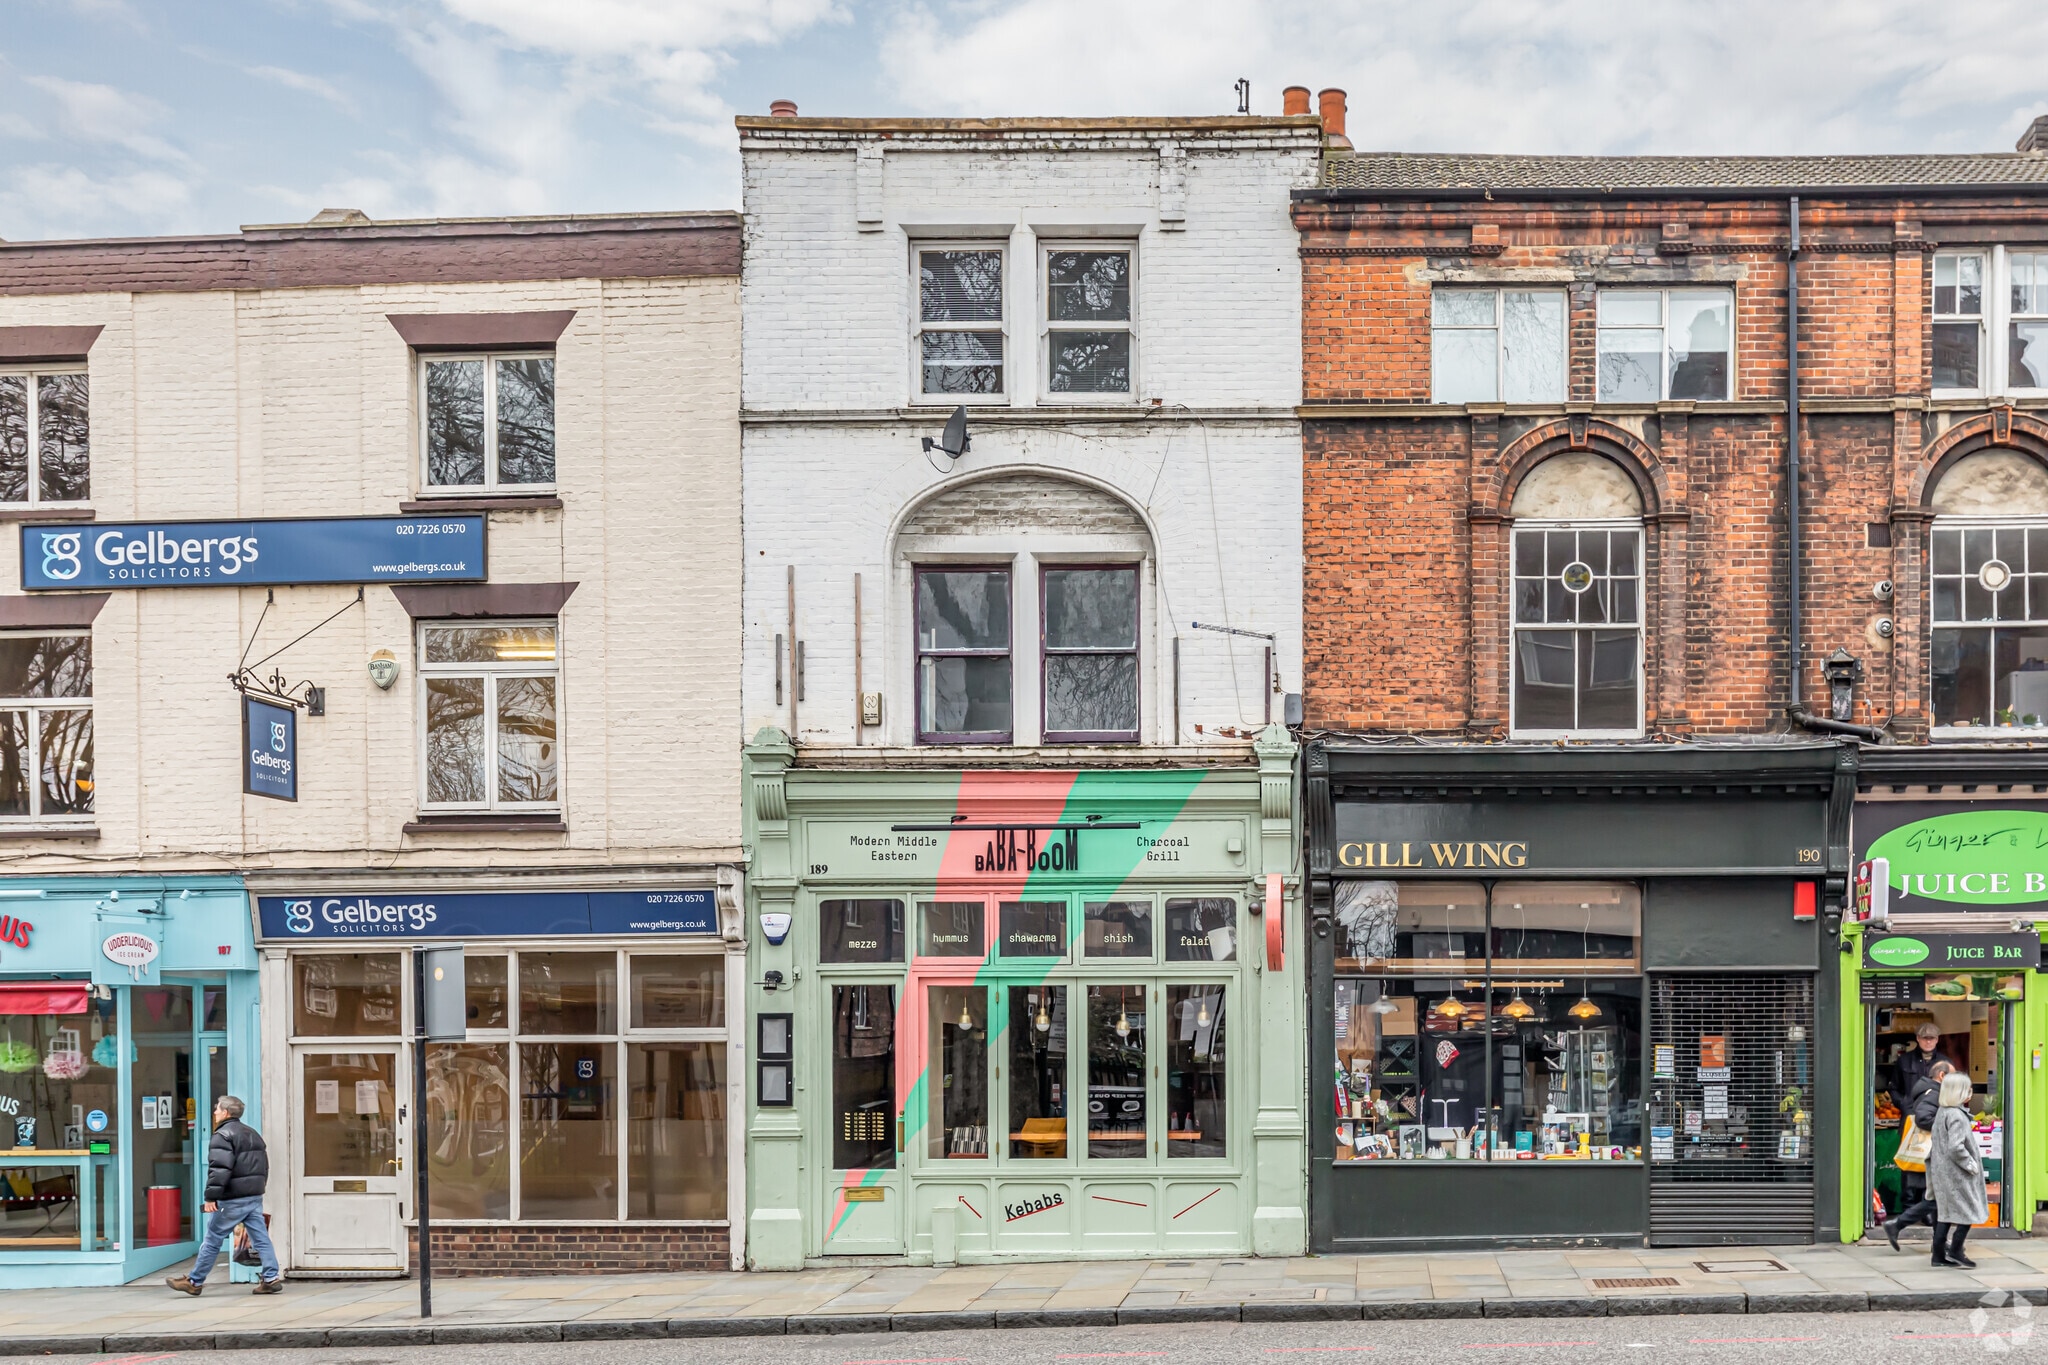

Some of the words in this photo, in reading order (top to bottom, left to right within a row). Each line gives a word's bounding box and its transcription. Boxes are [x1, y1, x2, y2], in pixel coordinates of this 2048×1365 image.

[396, 525, 414, 535] 020
[417, 524, 440, 534] 7226
[442, 523, 466, 534] 0570
[94, 530, 259, 575] Gelbergs
[109, 567, 211, 579] SOLICITORS
[372, 561, 466, 575] www.gelbergs.co.uk
[251, 749, 291, 775] Gelbergs
[256, 772, 288, 785] SOLICITORS
[850, 836, 891, 846] Modern
[897, 836, 938, 847] Middle
[1136, 836, 1190, 847] Charcoal
[975, 826, 1079, 871] BABA-BOOM
[871, 851, 918, 861] Eastern
[1146, 851, 1180, 861] Grill
[1338, 842, 1423, 867] GILL
[1429, 842, 1527, 867] WING
[1798, 849, 1820, 862] 190
[810, 864, 829, 875] 189
[1899, 872, 2011, 899] JUICE
[647, 895, 662, 903] 020
[664, 895, 683, 903] 7226
[685, 894, 705, 902] 0570
[321, 899, 437, 930] Gelbergs
[333, 924, 405, 933] SOLICITORS
[630, 920, 706, 930] www.gelbergs.co.uk
[933, 933, 969, 943] hummus
[1009, 933, 1057, 943] shawarma
[1103, 933, 1134, 943] shish
[1181, 936, 1210, 946] falaf
[107, 935, 153, 953] UDDERLICIOUS
[848, 940, 877, 949] mezze
[1005, 1193, 1063, 1220] Kebabs
